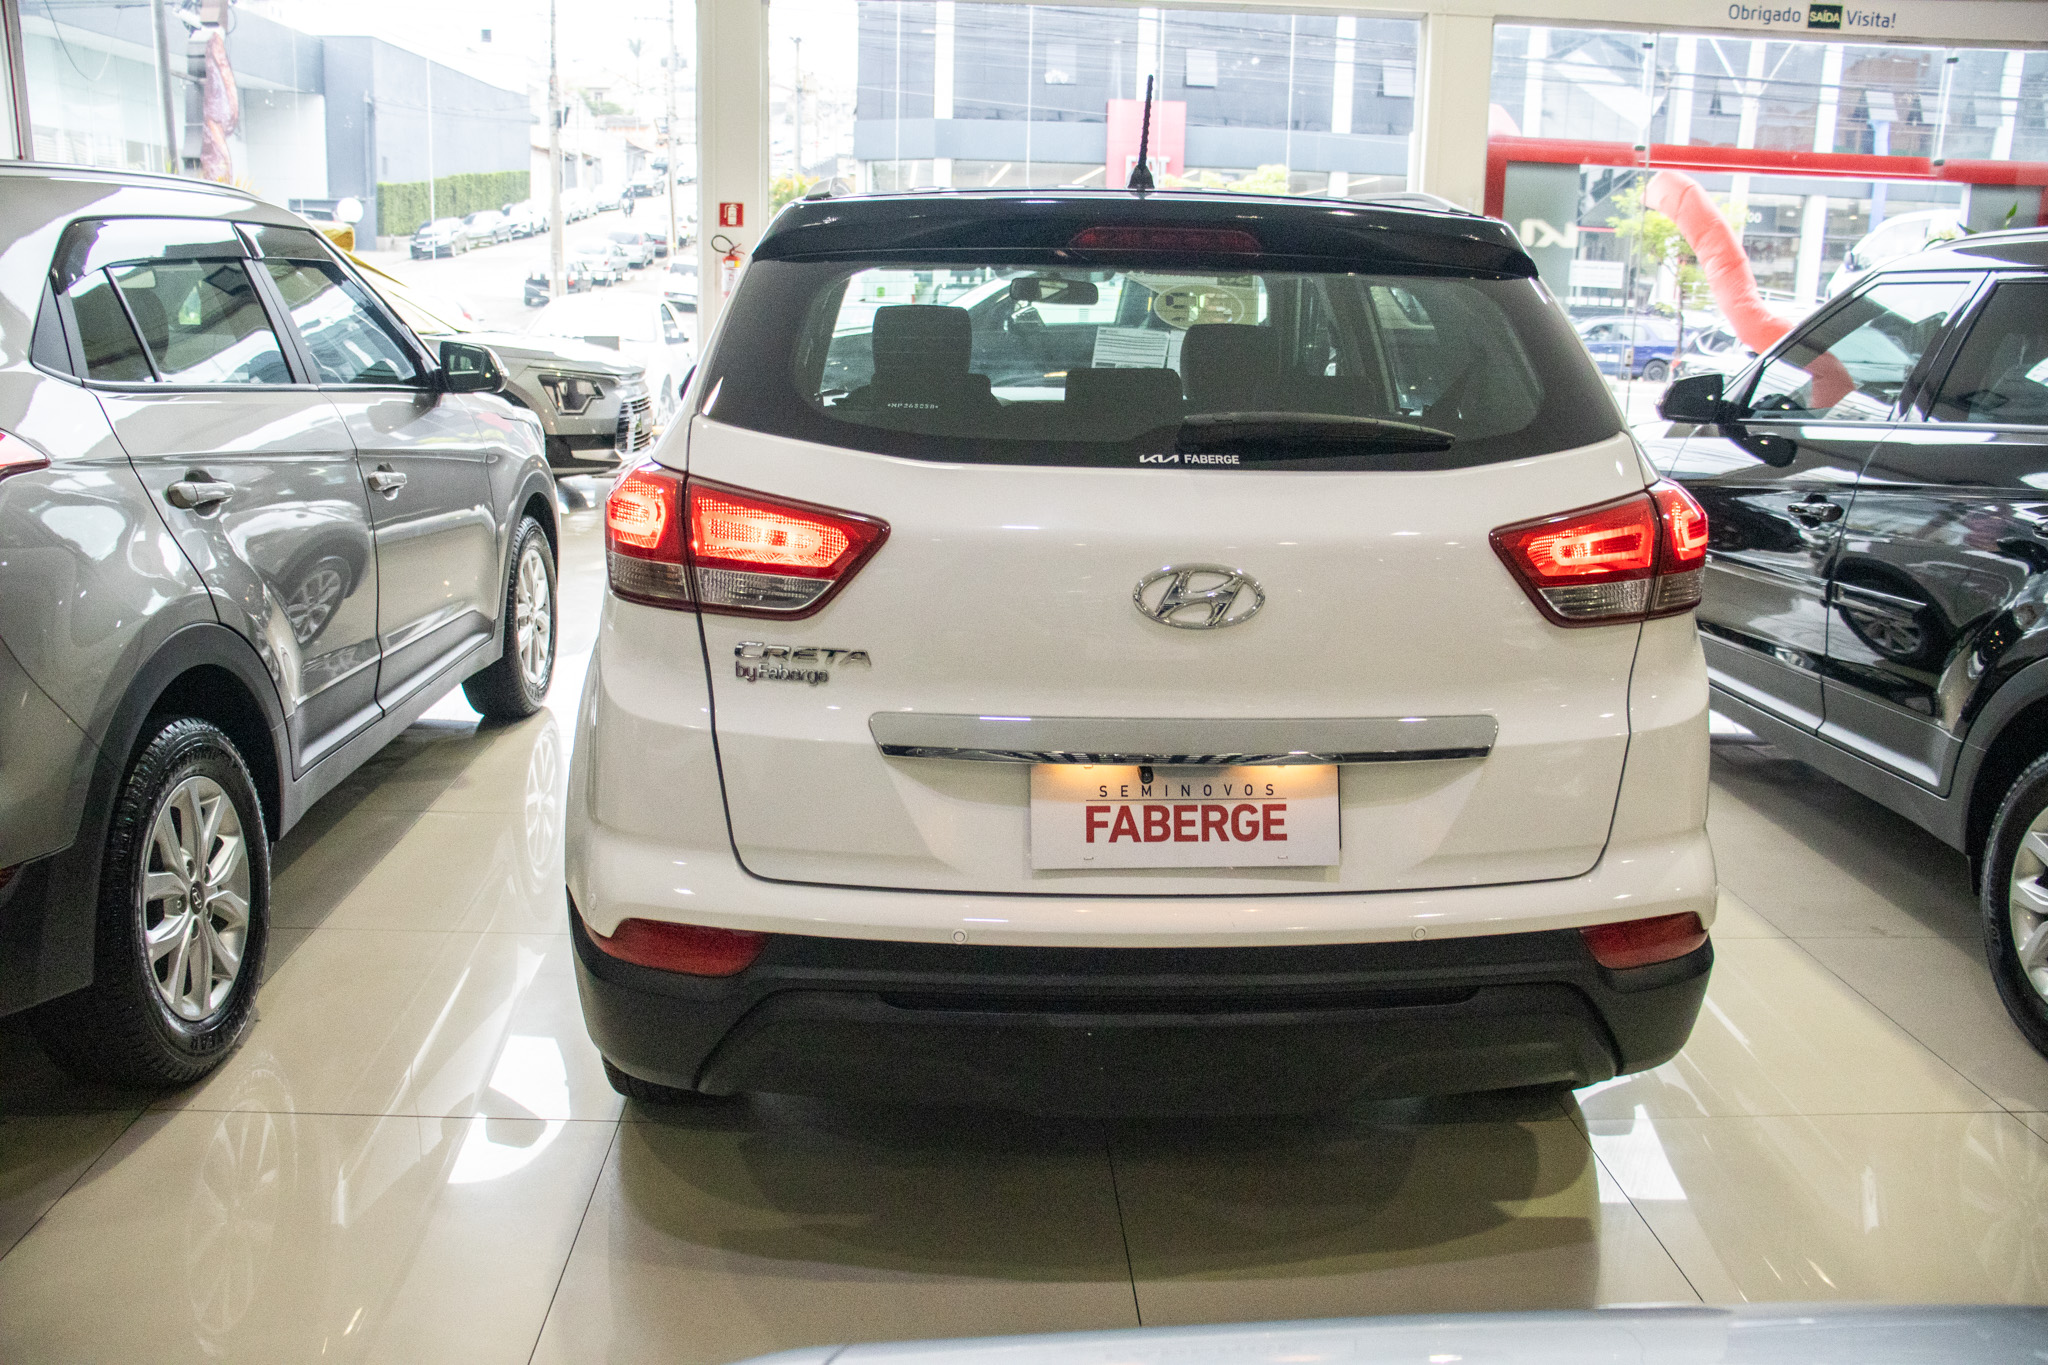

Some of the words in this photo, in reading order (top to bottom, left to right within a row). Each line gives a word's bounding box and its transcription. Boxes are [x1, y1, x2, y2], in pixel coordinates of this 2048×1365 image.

[1728, 4, 1801, 25] Obrigado
[1847, 10, 1897, 29] Visita!
[1809, 10, 1840, 23] SAÍDA
[1139, 454, 1180, 464] KIA
[1183, 454, 1240, 465] FABERGE
[734, 641, 872, 667] CRETA
[735, 660, 757, 683] by
[758, 662, 830, 687] Faberge
[1099, 783, 1275, 798] SEMINOVOS
[1085, 803, 1288, 844] FABERGE
